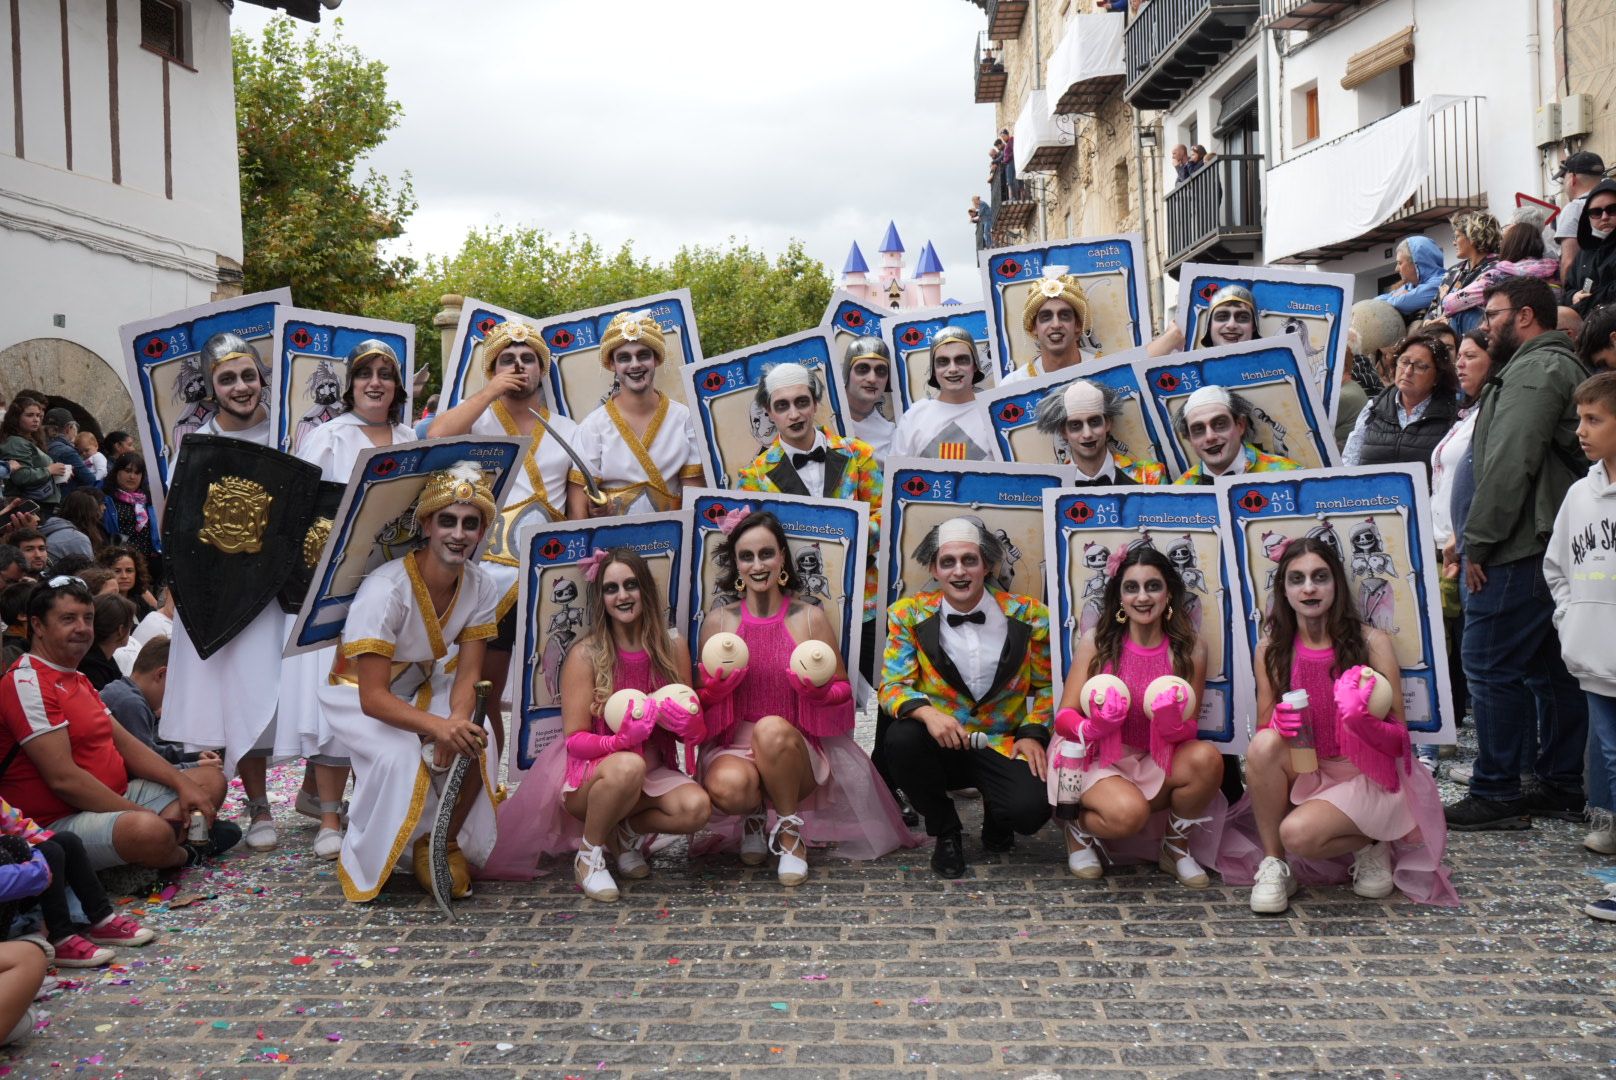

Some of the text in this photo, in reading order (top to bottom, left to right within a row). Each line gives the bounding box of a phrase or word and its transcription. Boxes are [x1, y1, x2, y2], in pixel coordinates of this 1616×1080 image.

[1024, 258, 1039, 267] A 4
[1096, 260, 1121, 268] moro
[1024, 266, 1041, 277] D 1
[1288, 300, 1321, 312] Jaume
[648, 306, 672, 319] pita
[866, 319, 873, 327] A
[576, 326, 591, 336] A 4
[862, 326, 871, 335] D
[170, 332, 185, 344] A 3
[314, 333, 328, 342] A 3
[577, 335, 594, 346] D 1
[171, 343, 188, 354] D 5
[314, 342, 328, 352] D 5
[727, 367, 743, 378] A 2
[1181, 371, 1197, 381] A 2
[1241, 368, 1286, 381] Monleon
[728, 377, 744, 387] D 2
[1183, 381, 1191, 390] D
[1026, 401, 1033, 409] A
[401, 457, 408, 465] A
[933, 480, 952, 489] A 2
[933, 489, 952, 499] D 2
[1315, 494, 1399, 509] monleonetes
[1272, 502, 1282, 513] D
[1097, 514, 1106, 524] D
[1138, 512, 1216, 524] monleonetes
[782, 521, 844, 535] onleonetes
[626, 540, 671, 552] leonetes
[568, 549, 576, 560] D
